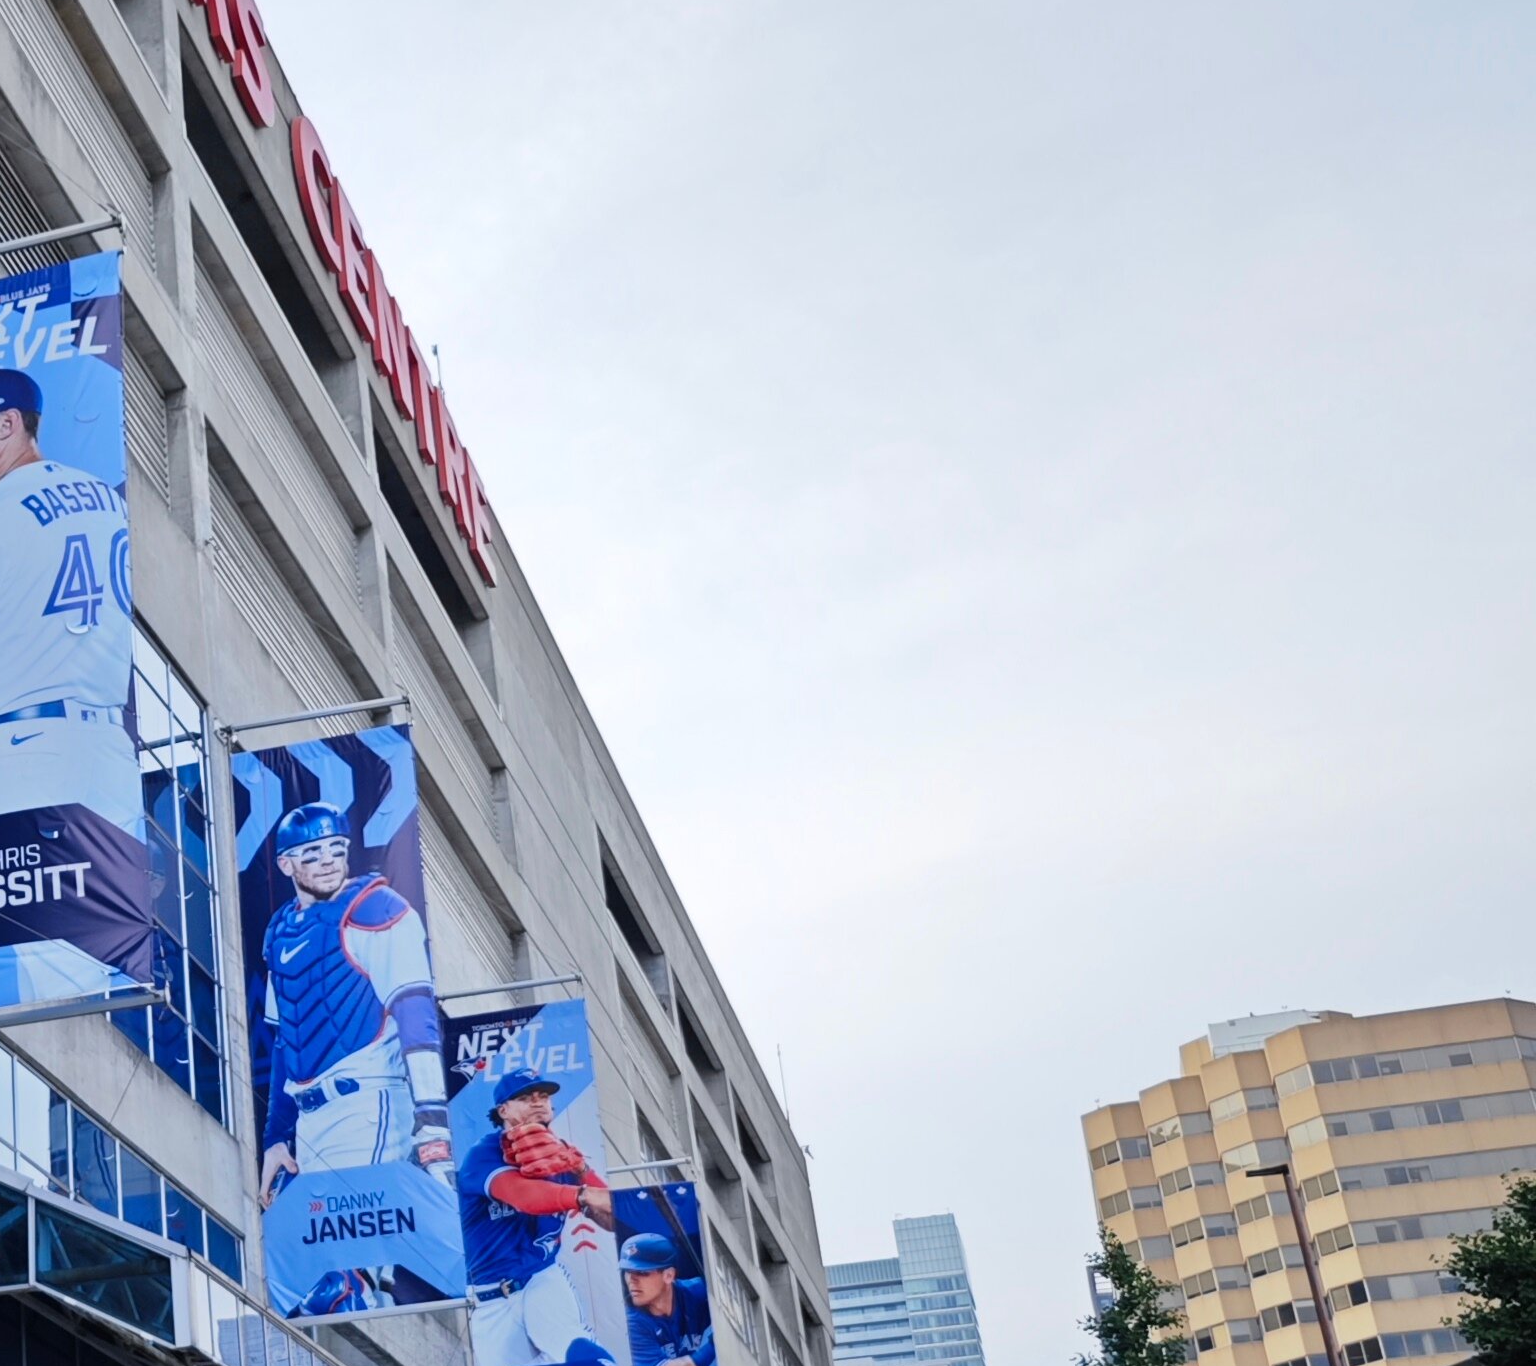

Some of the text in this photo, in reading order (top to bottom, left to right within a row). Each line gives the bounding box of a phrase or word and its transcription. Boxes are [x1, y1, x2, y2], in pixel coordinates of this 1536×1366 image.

[0, 290, 25, 304] BLUE
[25, 284, 51, 299] JAYS
[290, 116, 496, 588] CENTRE
[457, 1022, 543, 1061] NEXT
[484, 1042, 584, 1082] LEVEL
[327, 1190, 385, 1213] DANNY
[302, 1206, 416, 1245] JANSEN
